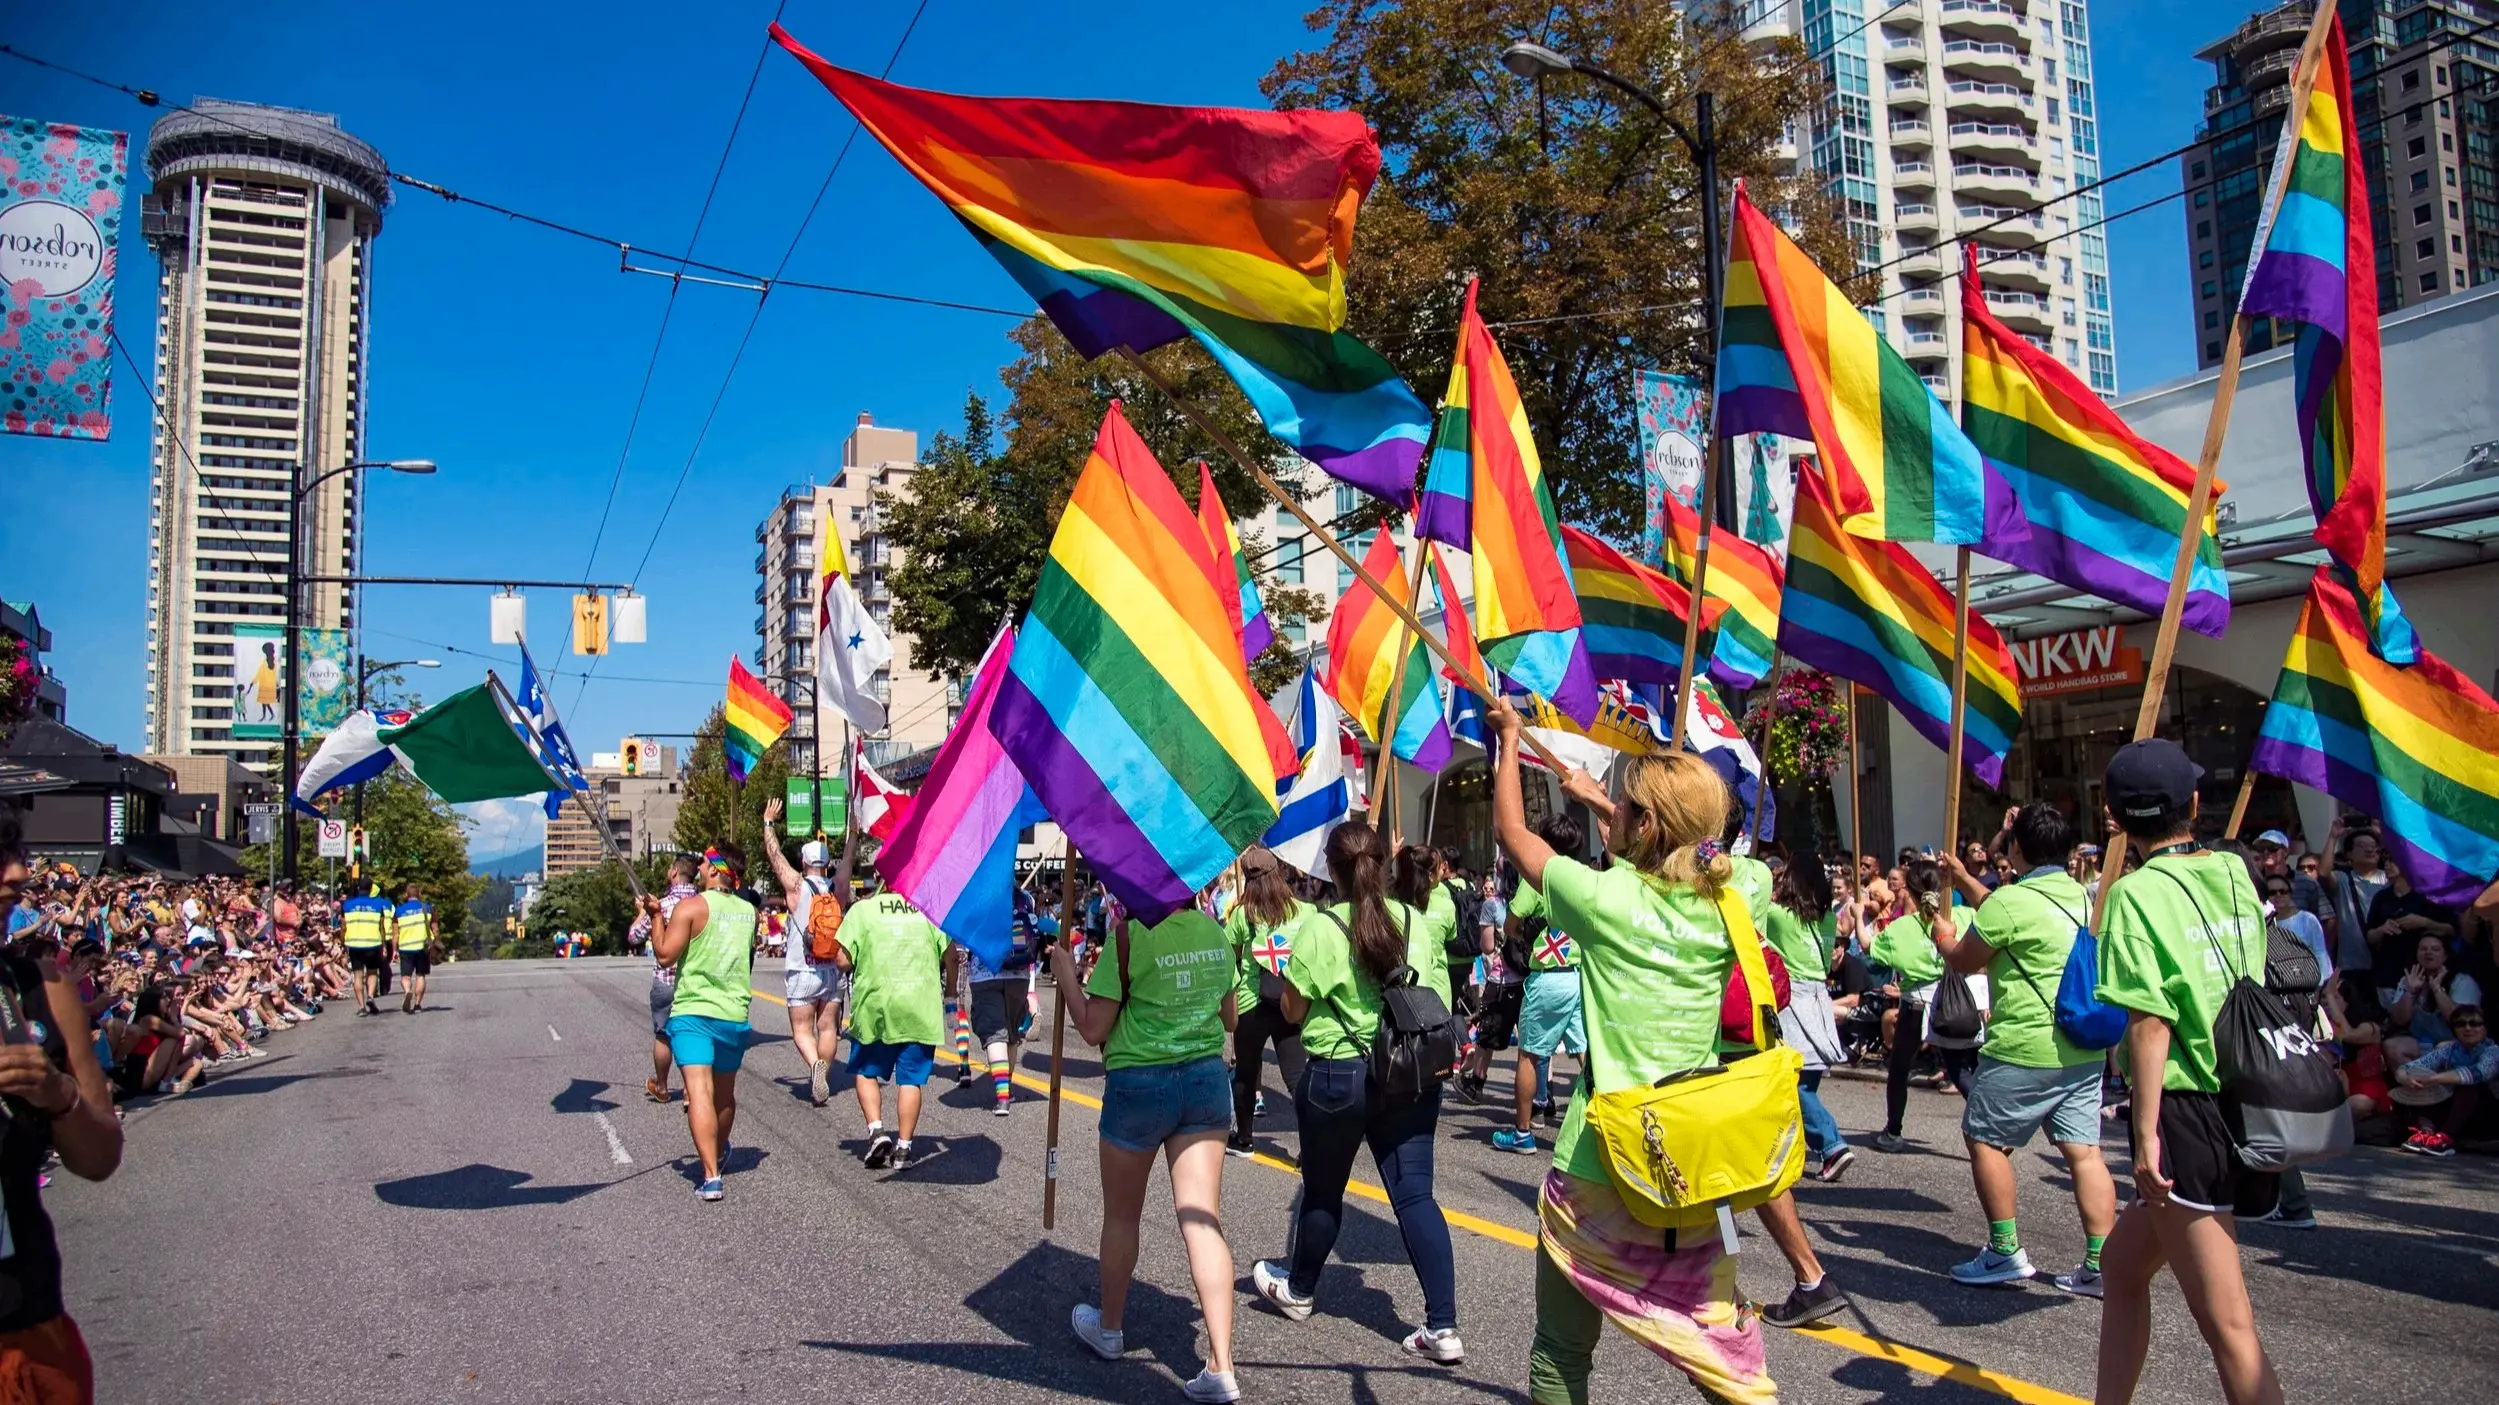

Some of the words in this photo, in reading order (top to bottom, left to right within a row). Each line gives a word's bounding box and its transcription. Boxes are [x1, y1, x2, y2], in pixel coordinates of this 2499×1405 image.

[1658, 444, 1702, 471] robson
[2008, 625, 2117, 680] NKW
[2026, 682, 2056, 694] WORLD
[2056, 675, 2099, 689] HANDBAG
[2100, 671, 2128, 683] STORE
[247, 804, 269, 814] JERVIS
